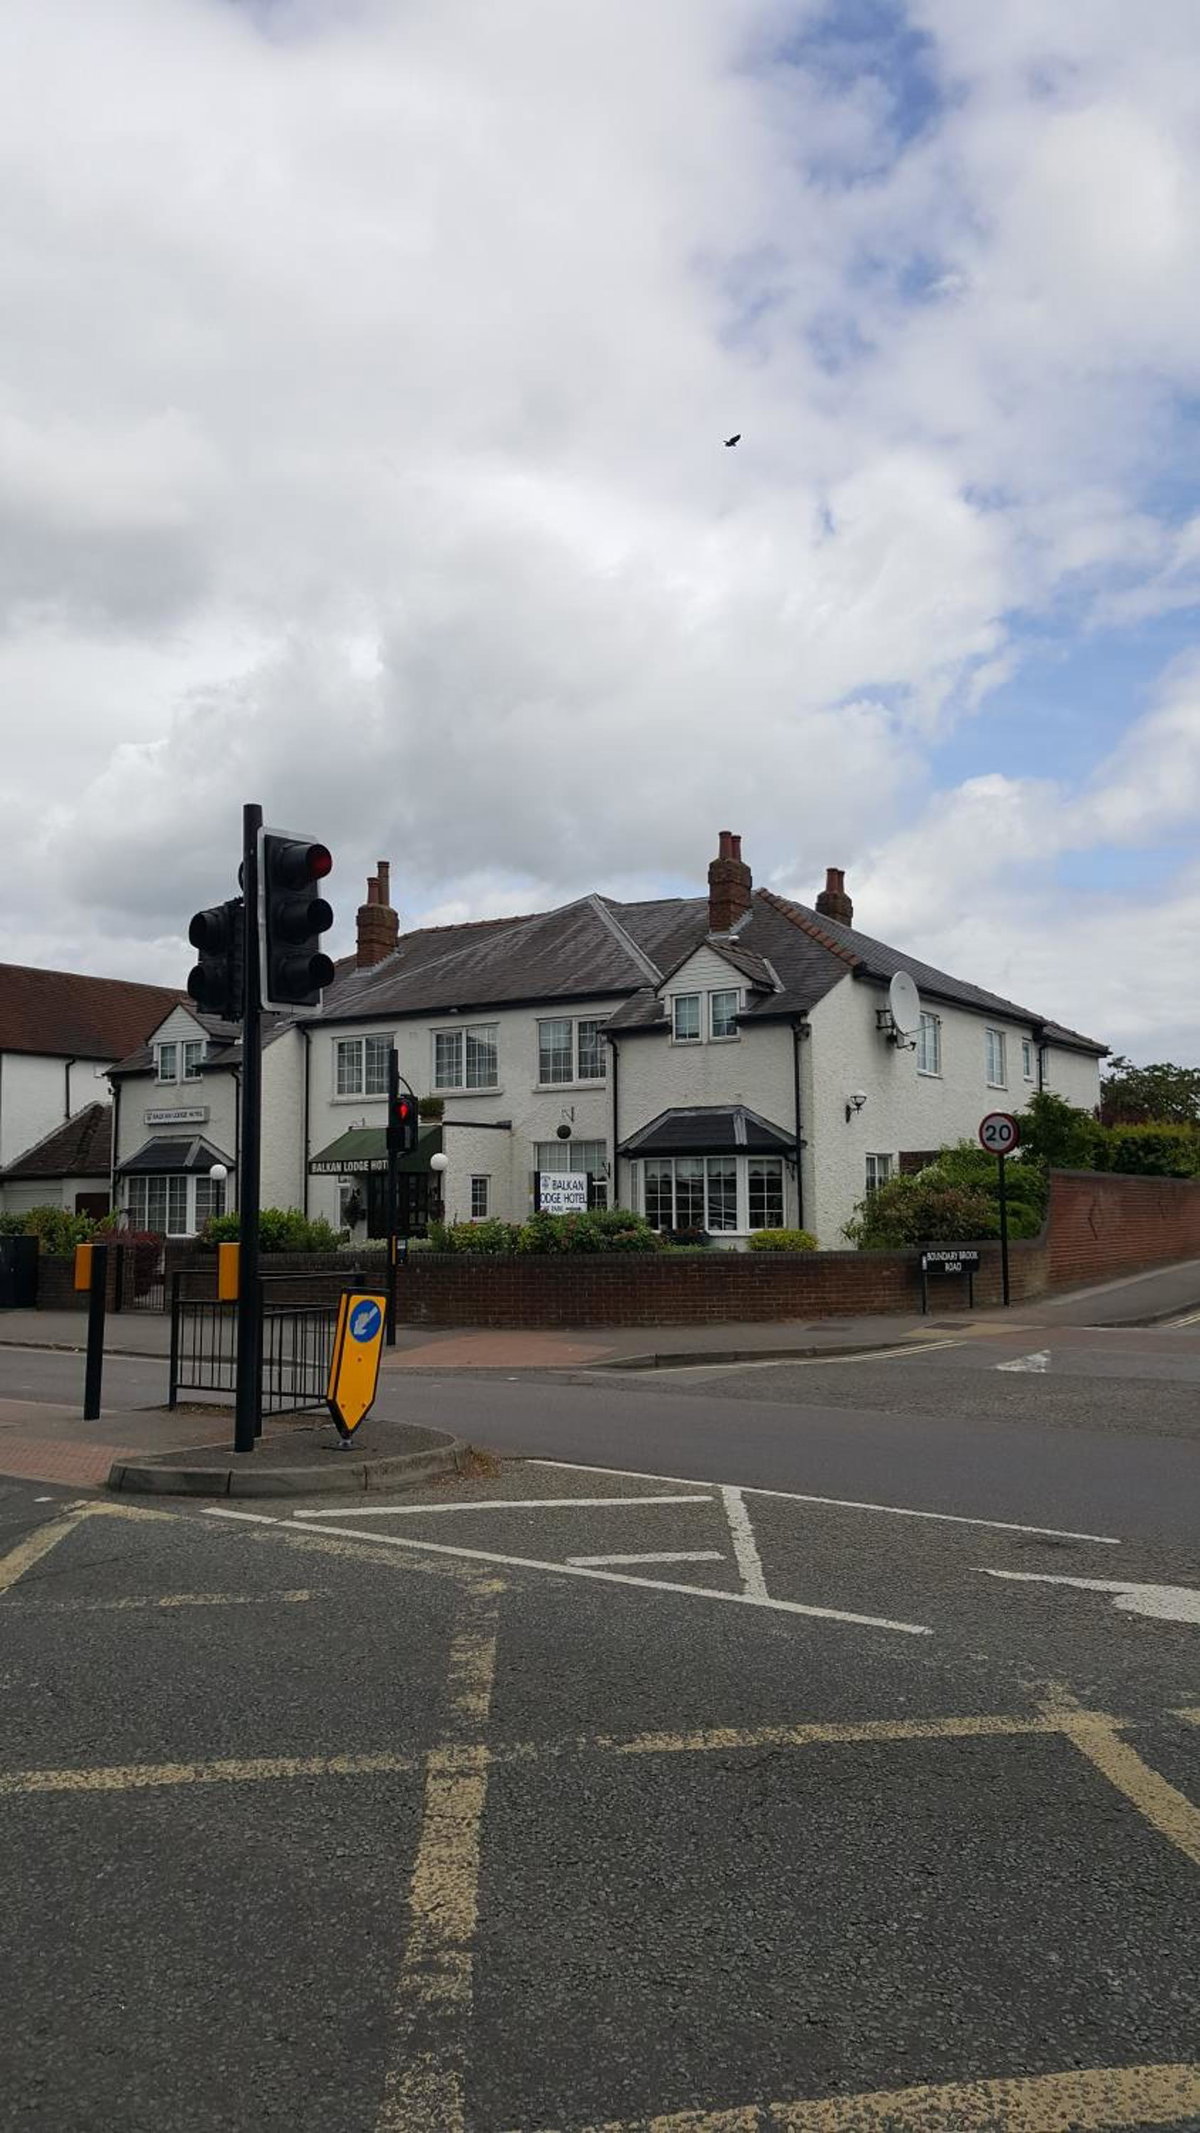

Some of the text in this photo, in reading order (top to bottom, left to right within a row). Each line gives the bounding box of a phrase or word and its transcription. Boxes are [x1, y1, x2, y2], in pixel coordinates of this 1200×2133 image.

[985, 1124, 1011, 1142] 20
[312, 1162, 342, 1173] BALKAN
[343, 1161, 369, 1172] LODGE
[552, 1180, 584, 1191] BALKAN
[540, 1192, 587, 1204] ODGE HOTEL
[927, 1251, 958, 1262] BOUNDARY
[946, 1262, 962, 1272] ROAD
